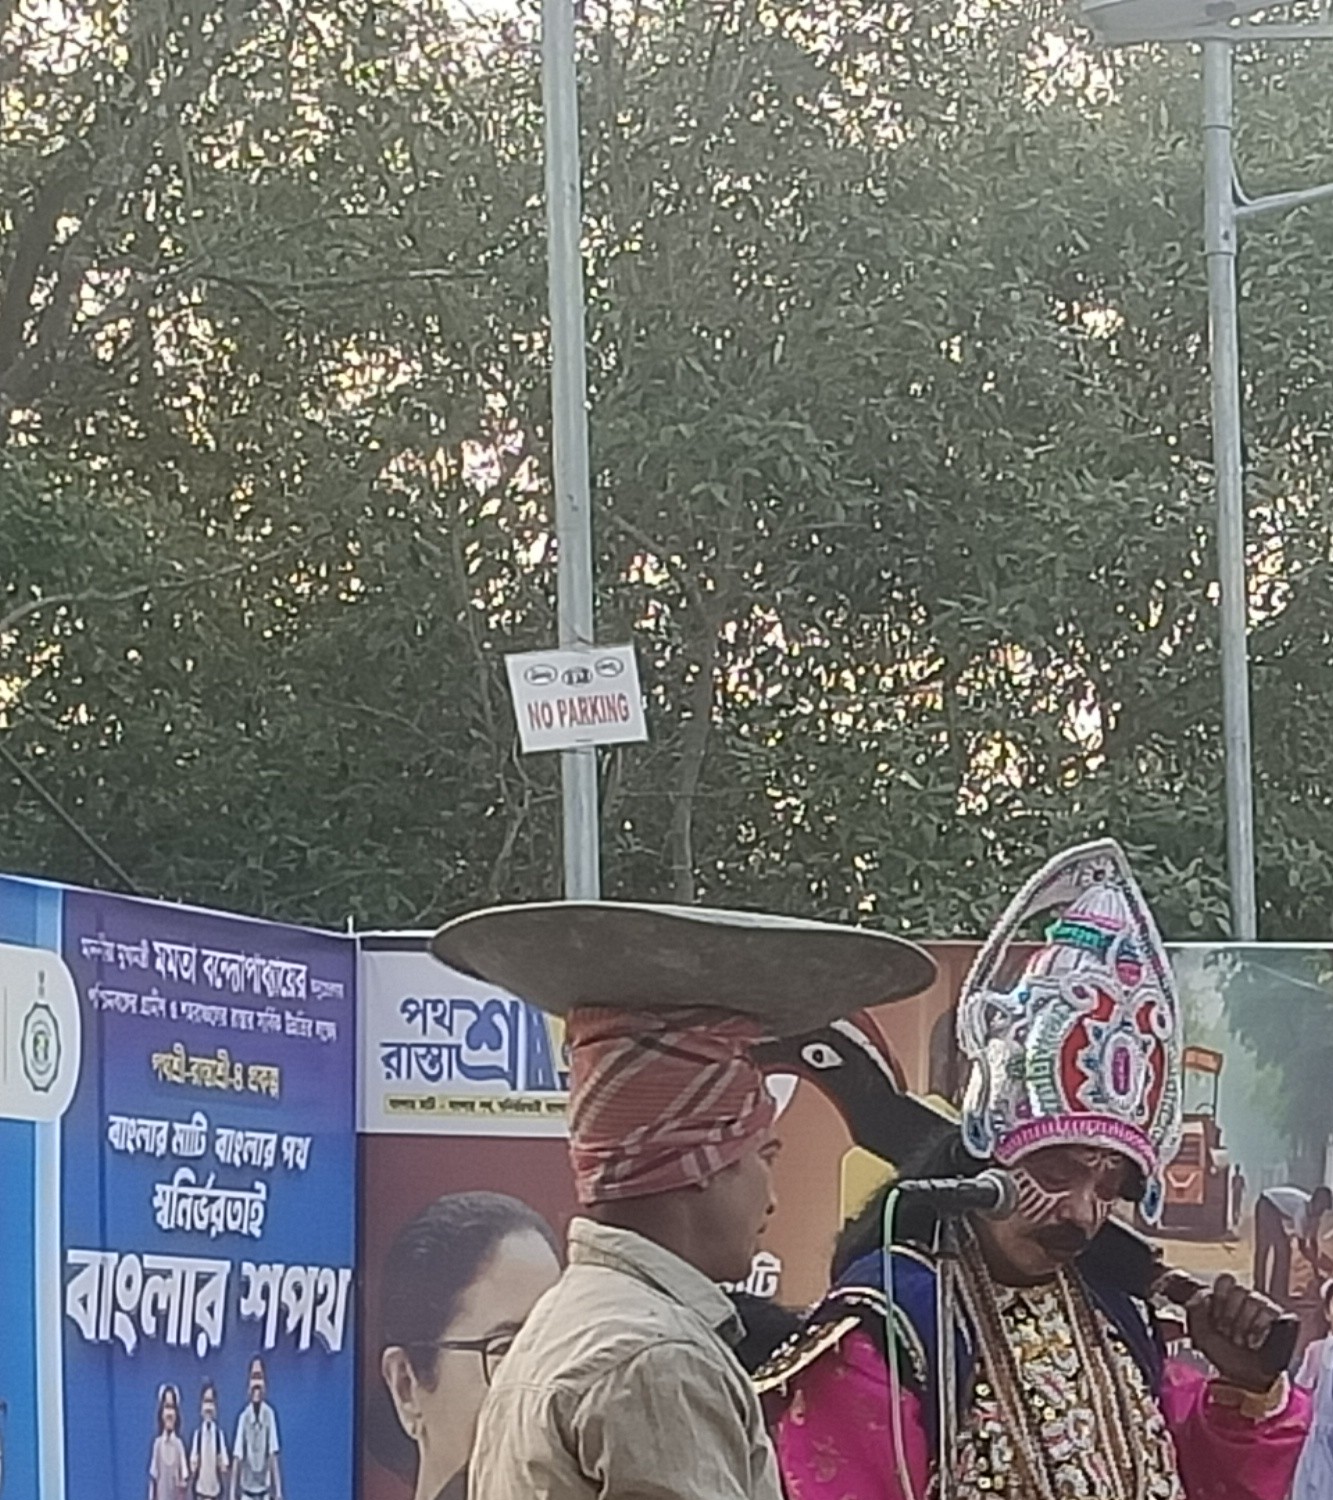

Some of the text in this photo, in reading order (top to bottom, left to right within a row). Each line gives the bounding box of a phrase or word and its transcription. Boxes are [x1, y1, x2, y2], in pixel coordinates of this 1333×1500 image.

[527, 692, 630, 731] NO PARKING
[153, 941, 197, 985] মমতা
[400, 998, 453, 1036] পথ
[379, 1042, 464, 1082] রাস্তা
[107, 1111, 312, 1169] বাংলার মাটি বাংলার পথ
[153, 1167, 266, 1238] স্বনির্ভরতাই
[65, 1249, 352, 1358] বাংলার শপথ
